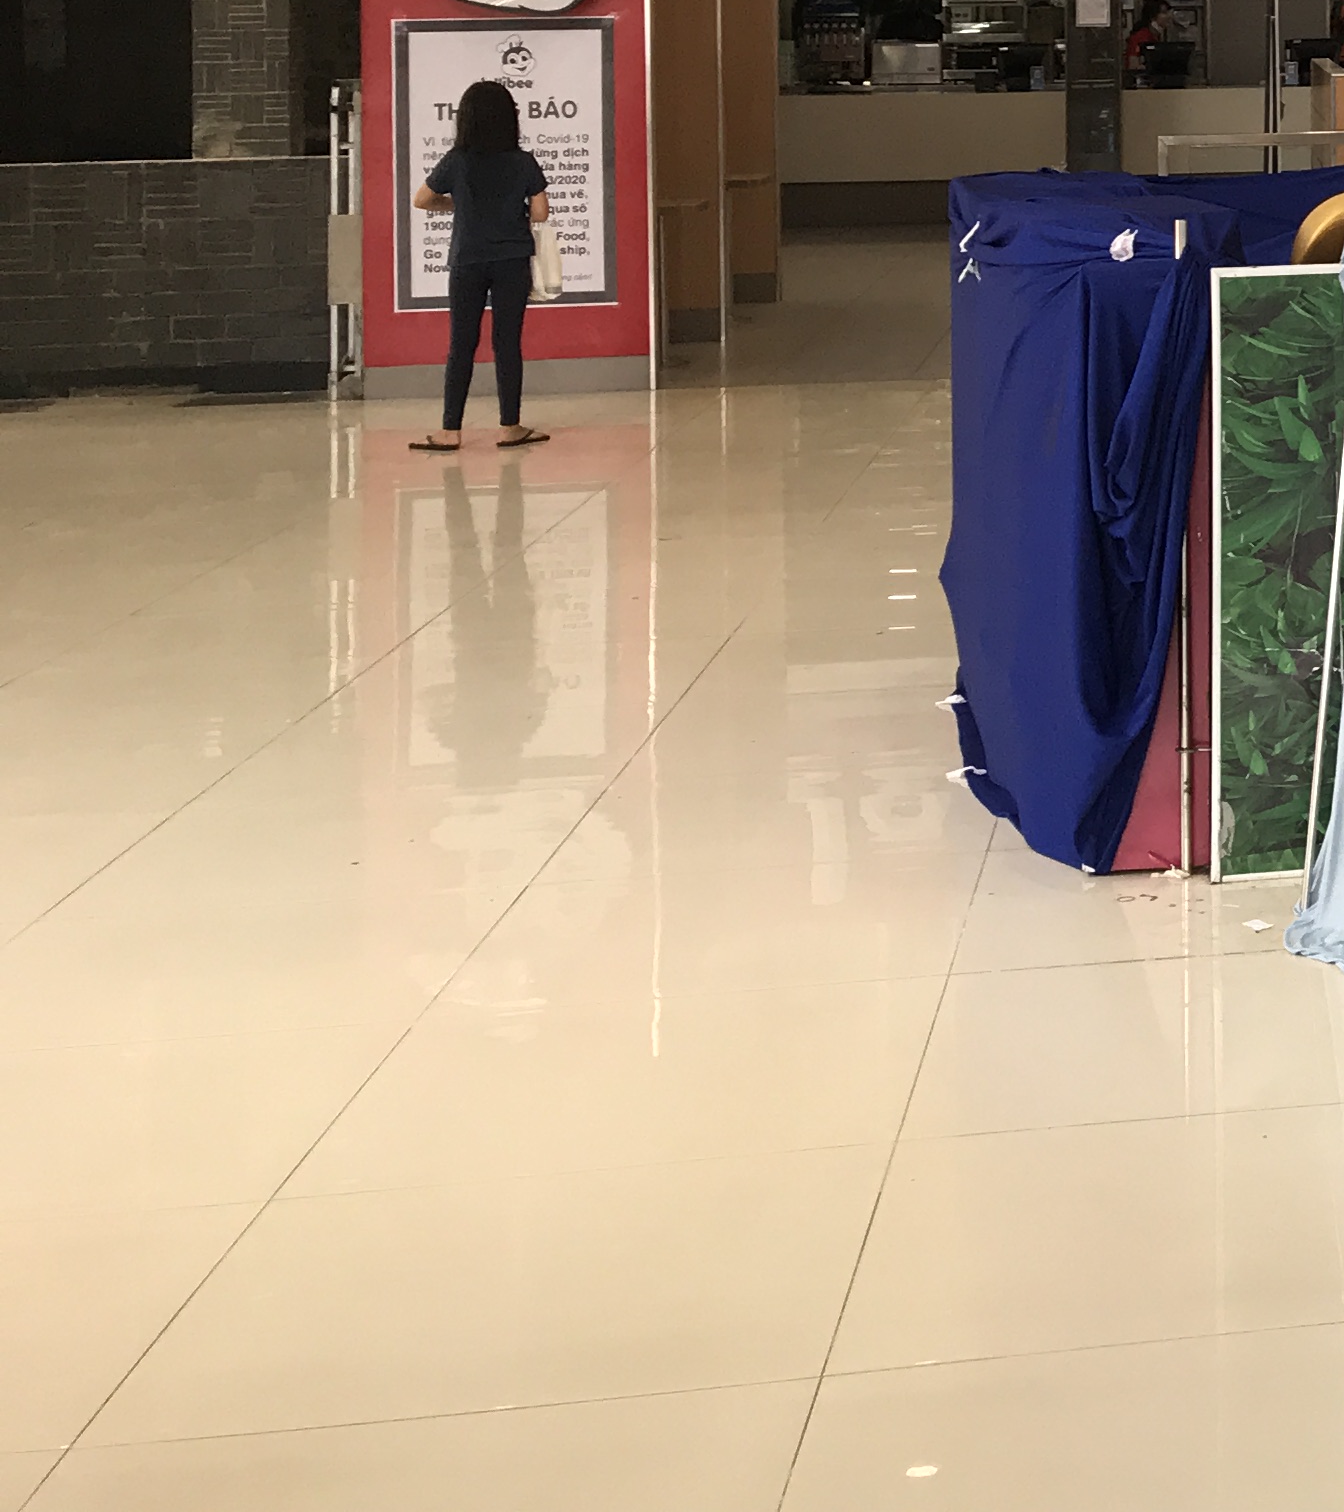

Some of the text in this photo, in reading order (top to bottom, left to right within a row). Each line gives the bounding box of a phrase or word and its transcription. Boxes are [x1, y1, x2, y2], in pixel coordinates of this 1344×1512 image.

[528, 96, 578, 120] BÁO
[536, 134, 590, 144] Covid-19
[563, 147, 589, 160] dịch
[559, 162, 590, 173] hàng
[423, 249, 442, 259] Go
